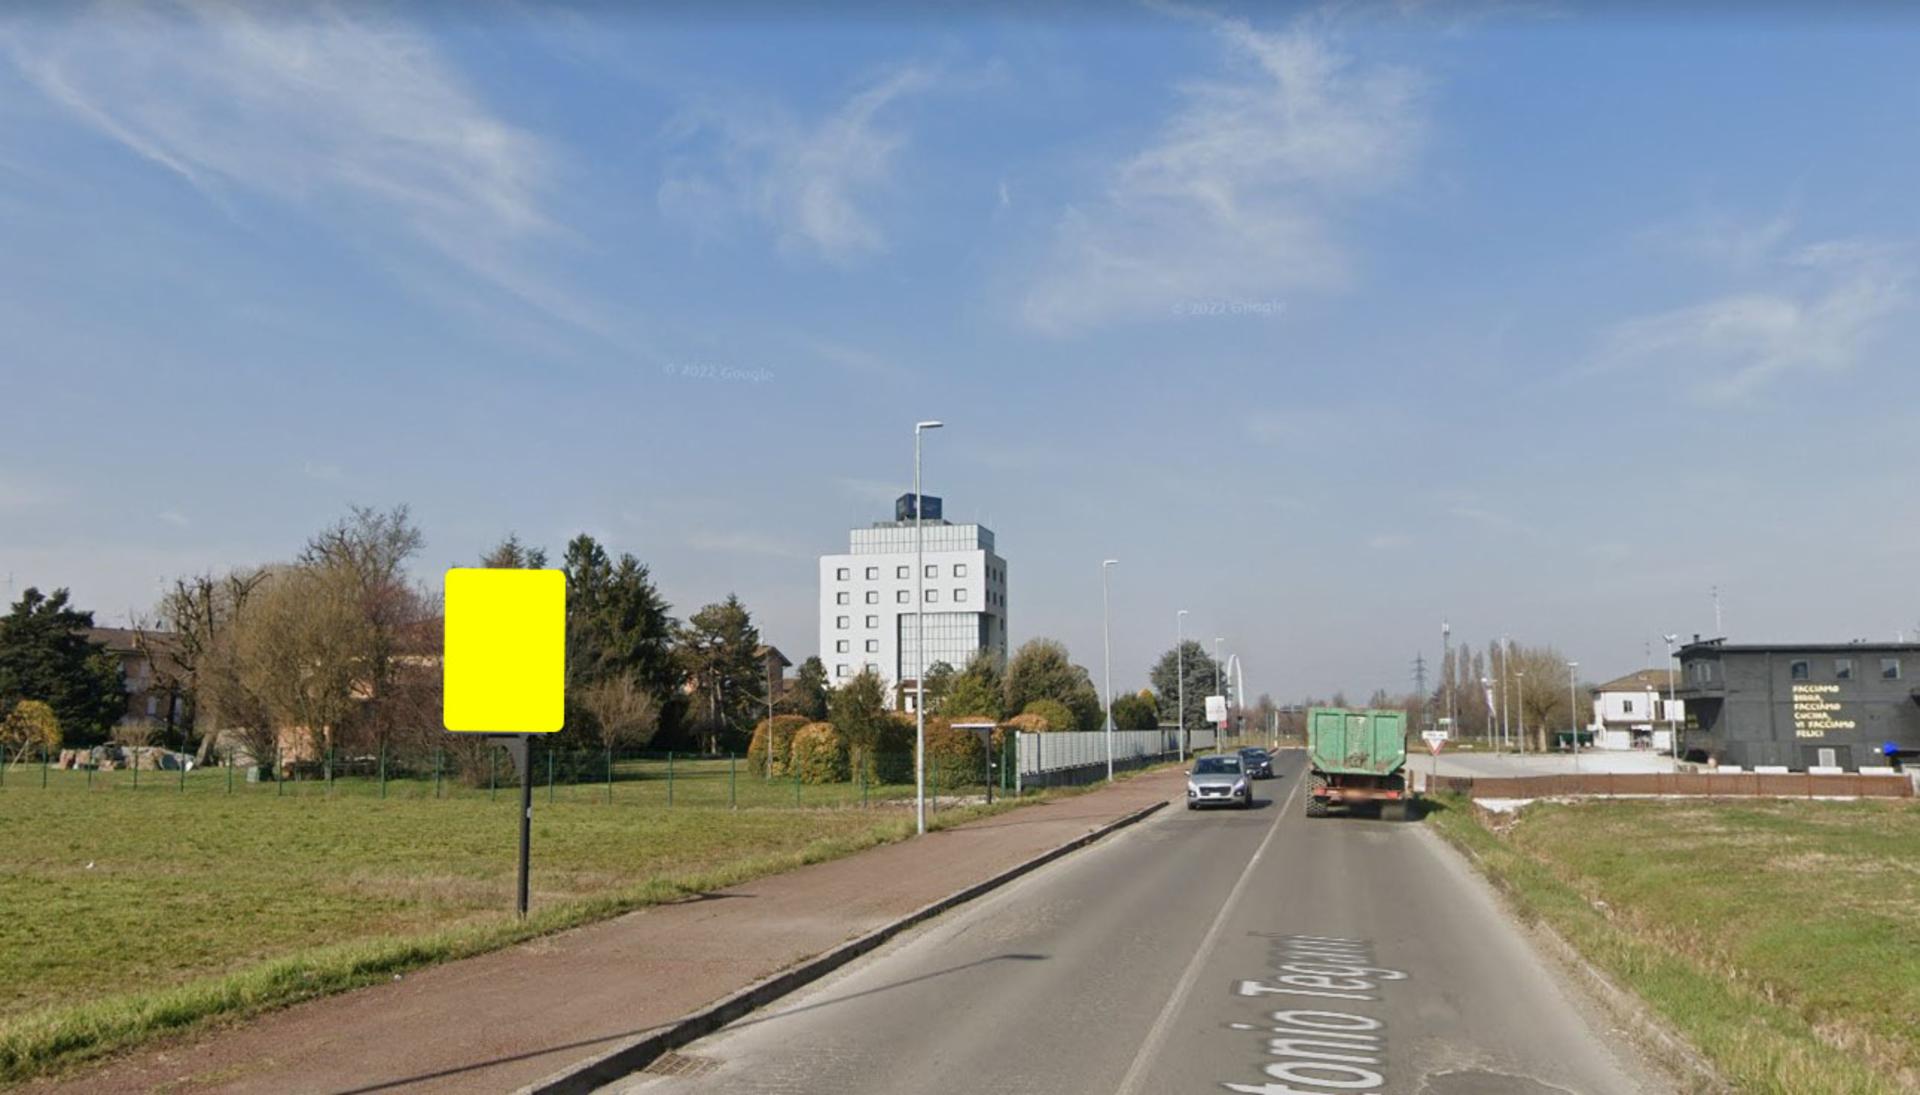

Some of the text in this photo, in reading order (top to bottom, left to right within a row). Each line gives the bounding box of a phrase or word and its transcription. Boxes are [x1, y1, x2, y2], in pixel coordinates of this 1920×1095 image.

[1792, 685, 1840, 693] FACCIAMO
[1794, 703, 1841, 711] FACCIAMO
[1808, 721, 1856, 729] FACCIAMO
